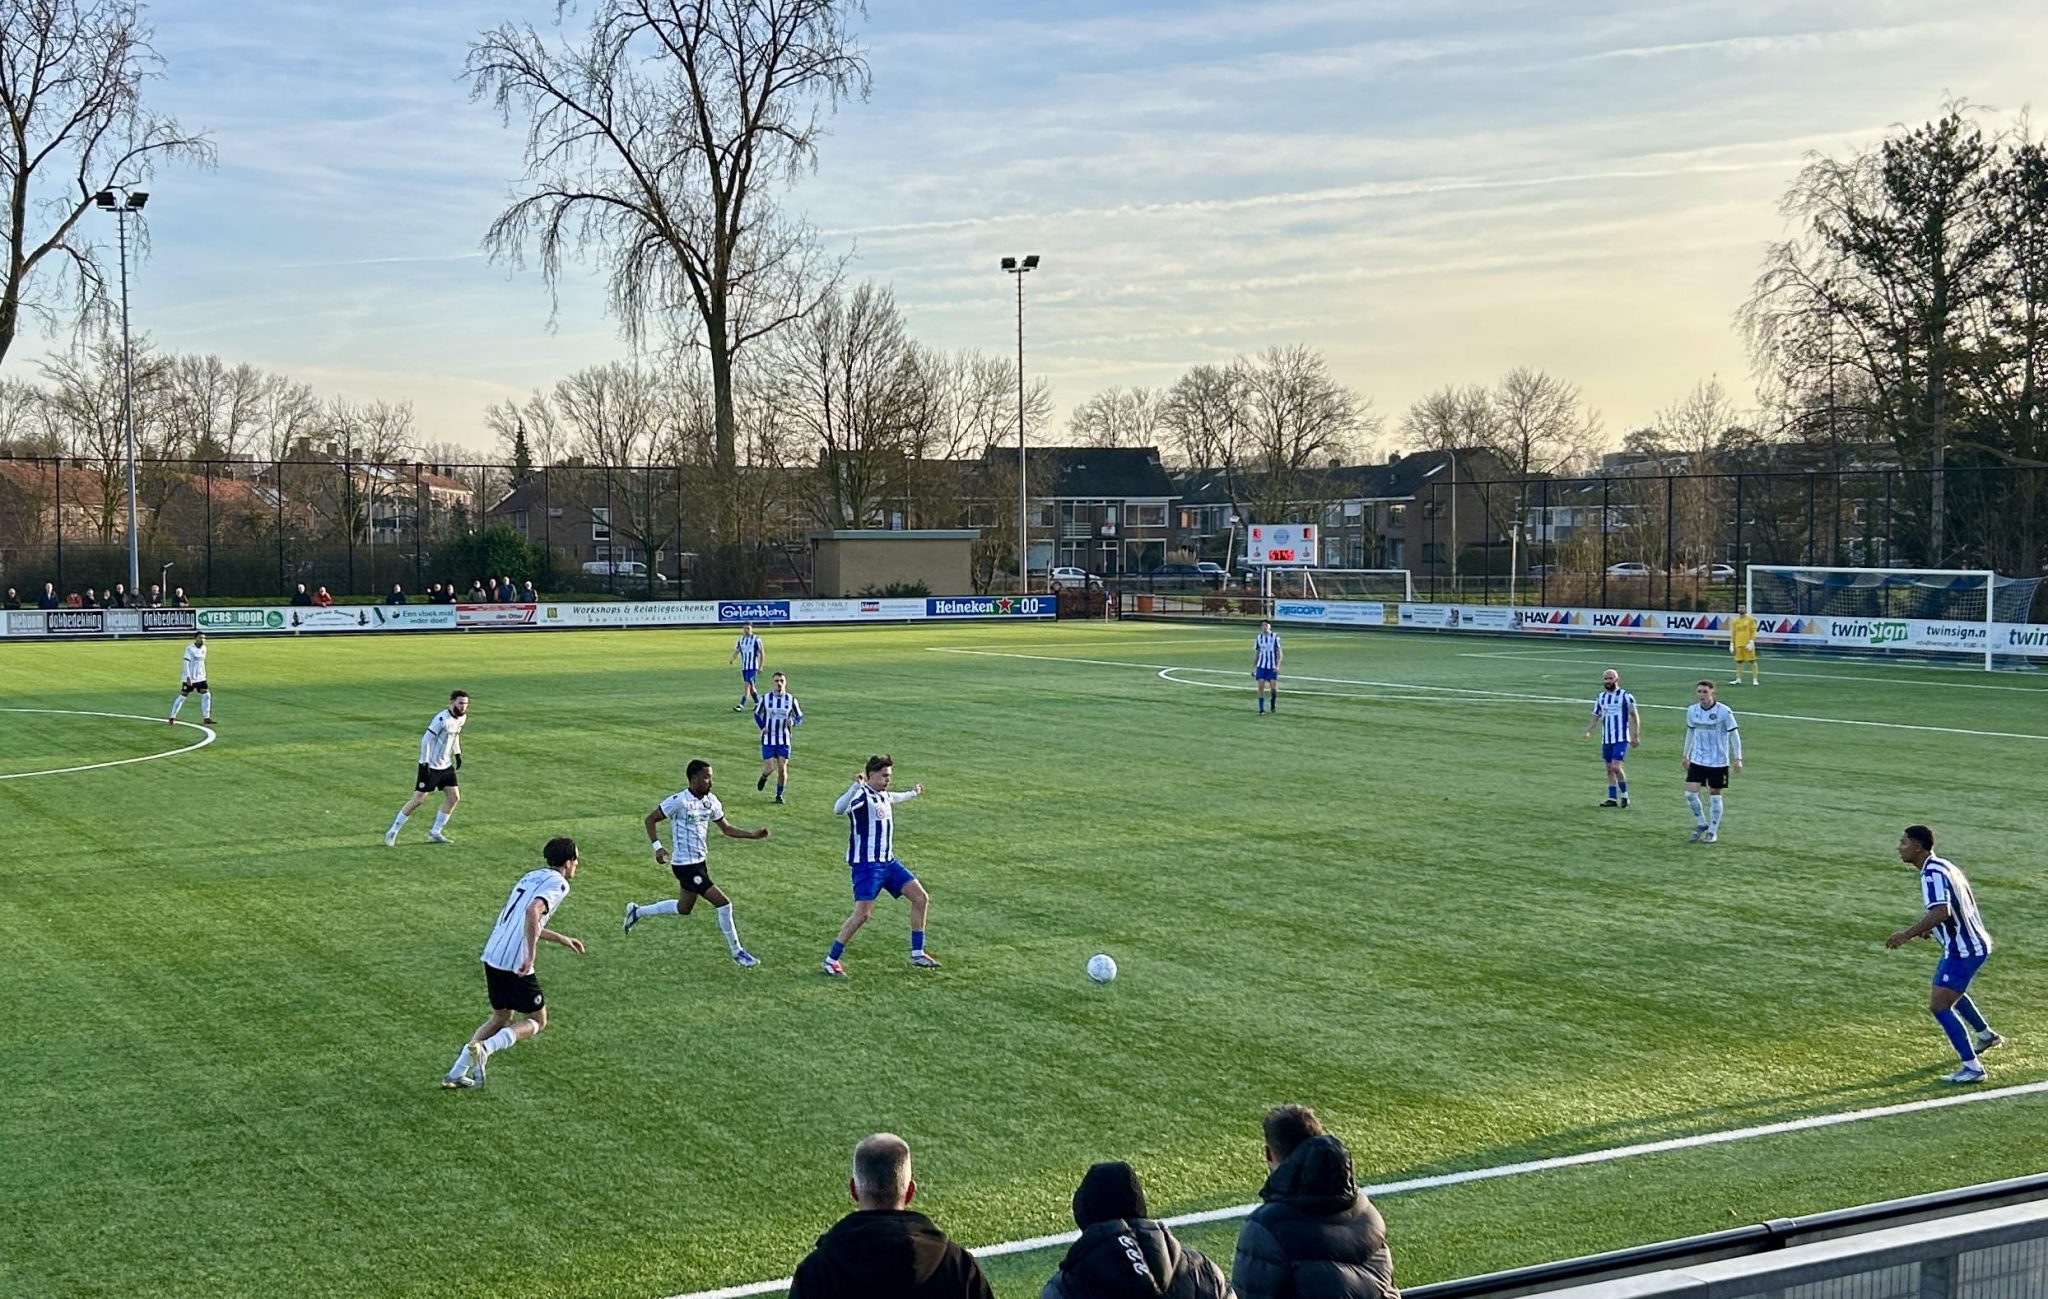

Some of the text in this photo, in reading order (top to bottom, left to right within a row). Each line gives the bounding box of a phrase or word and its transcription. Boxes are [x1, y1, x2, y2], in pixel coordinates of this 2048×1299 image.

[573, 605, 621, 615] Workshops
[633, 604, 715, 613] Relatiegeschenken
[721, 604, 787, 618] Gelderblom
[935, 600, 994, 614] Heineken
[1525, 611, 1549, 623] HAY
[1593, 614, 1619, 626] HAY
[1667, 616, 1695, 629] HAY
[1756, 619, 1777, 632] AY
[1926, 625, 1987, 639] twinsign.n
[503, 887, 526, 923] 7
